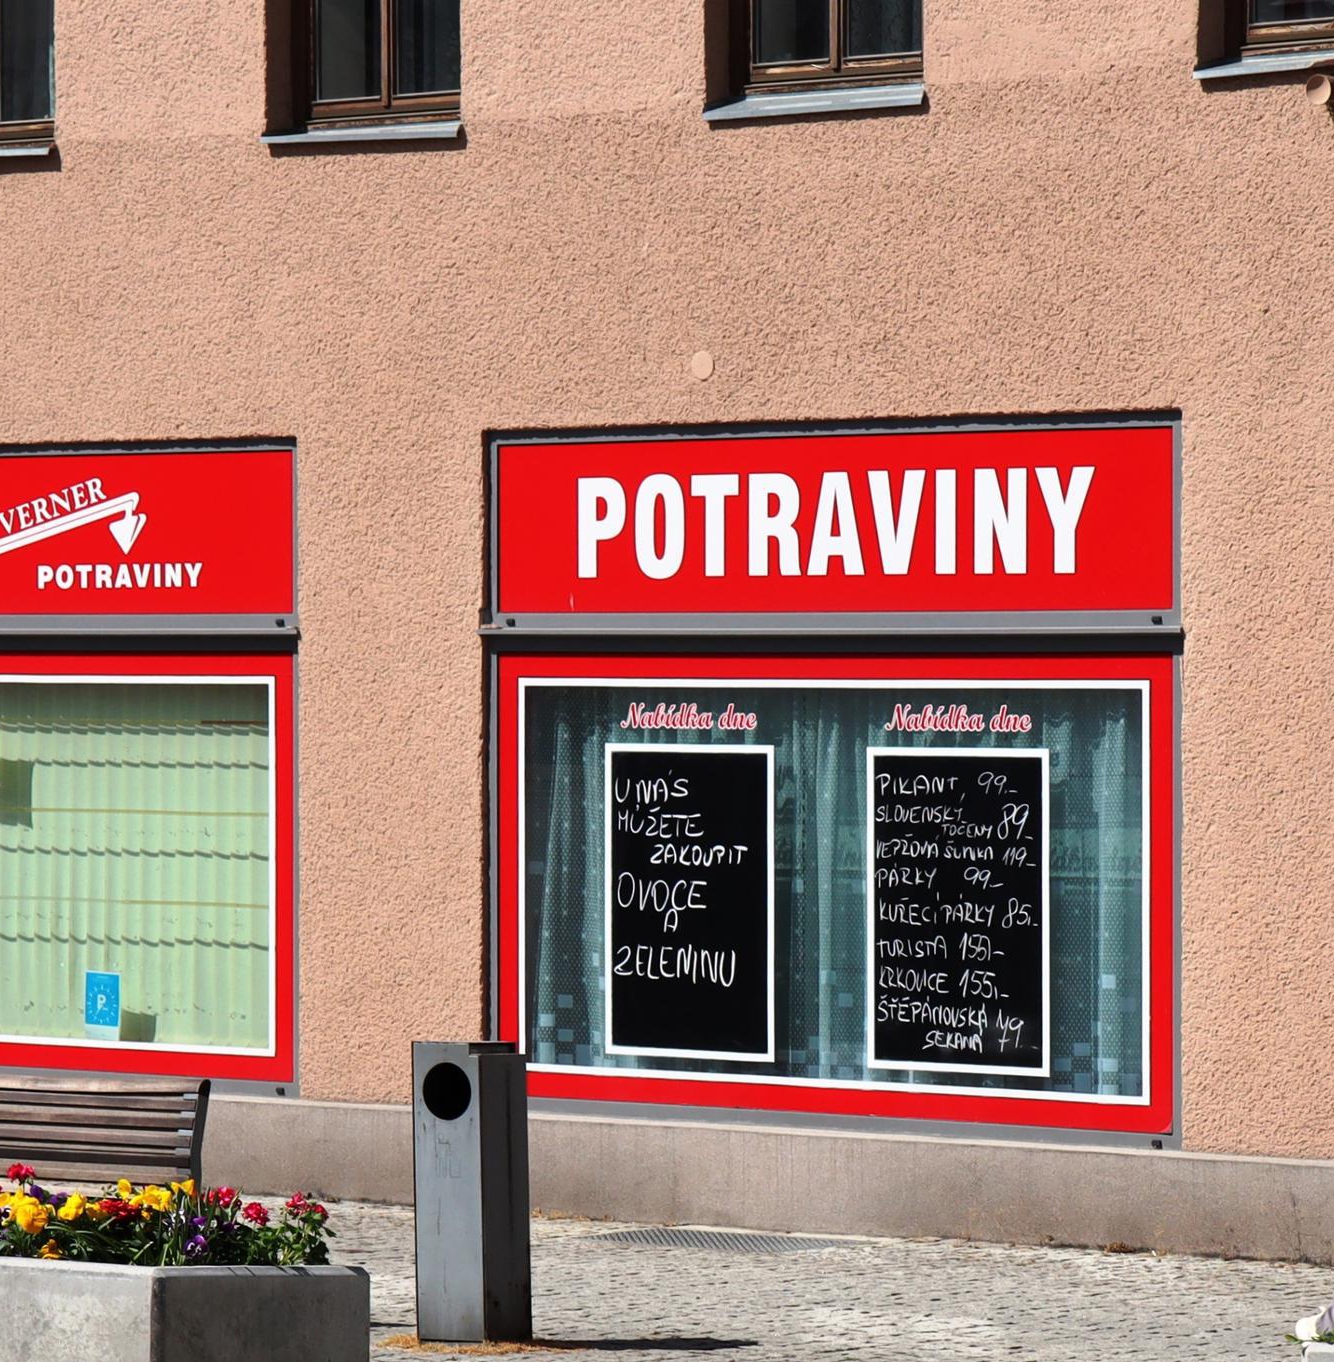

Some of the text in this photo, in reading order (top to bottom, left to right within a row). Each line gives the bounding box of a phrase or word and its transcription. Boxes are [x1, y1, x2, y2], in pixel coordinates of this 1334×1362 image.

[577, 466, 1096, 580] POTRAVINY
[37, 562, 203, 590] POTRAVINY
[621, 703, 757, 730] Nabídka dne
[885, 703, 1032, 732] Nabídka dne
[615, 769, 689, 804] U NÁS
[875, 772, 959, 797] PIKANT
[650, 843, 748, 867] ZAKOUPIT
[874, 862, 937, 889] PÁRKY
[617, 872, 707, 912] OVOCE
[664, 908, 679, 933] A
[940, 892, 995, 928] PÁRKY
[876, 935, 947, 959] TURISTA
[614, 944, 736, 987] ZELENINU
[878, 965, 950, 993] KRKOVICE
